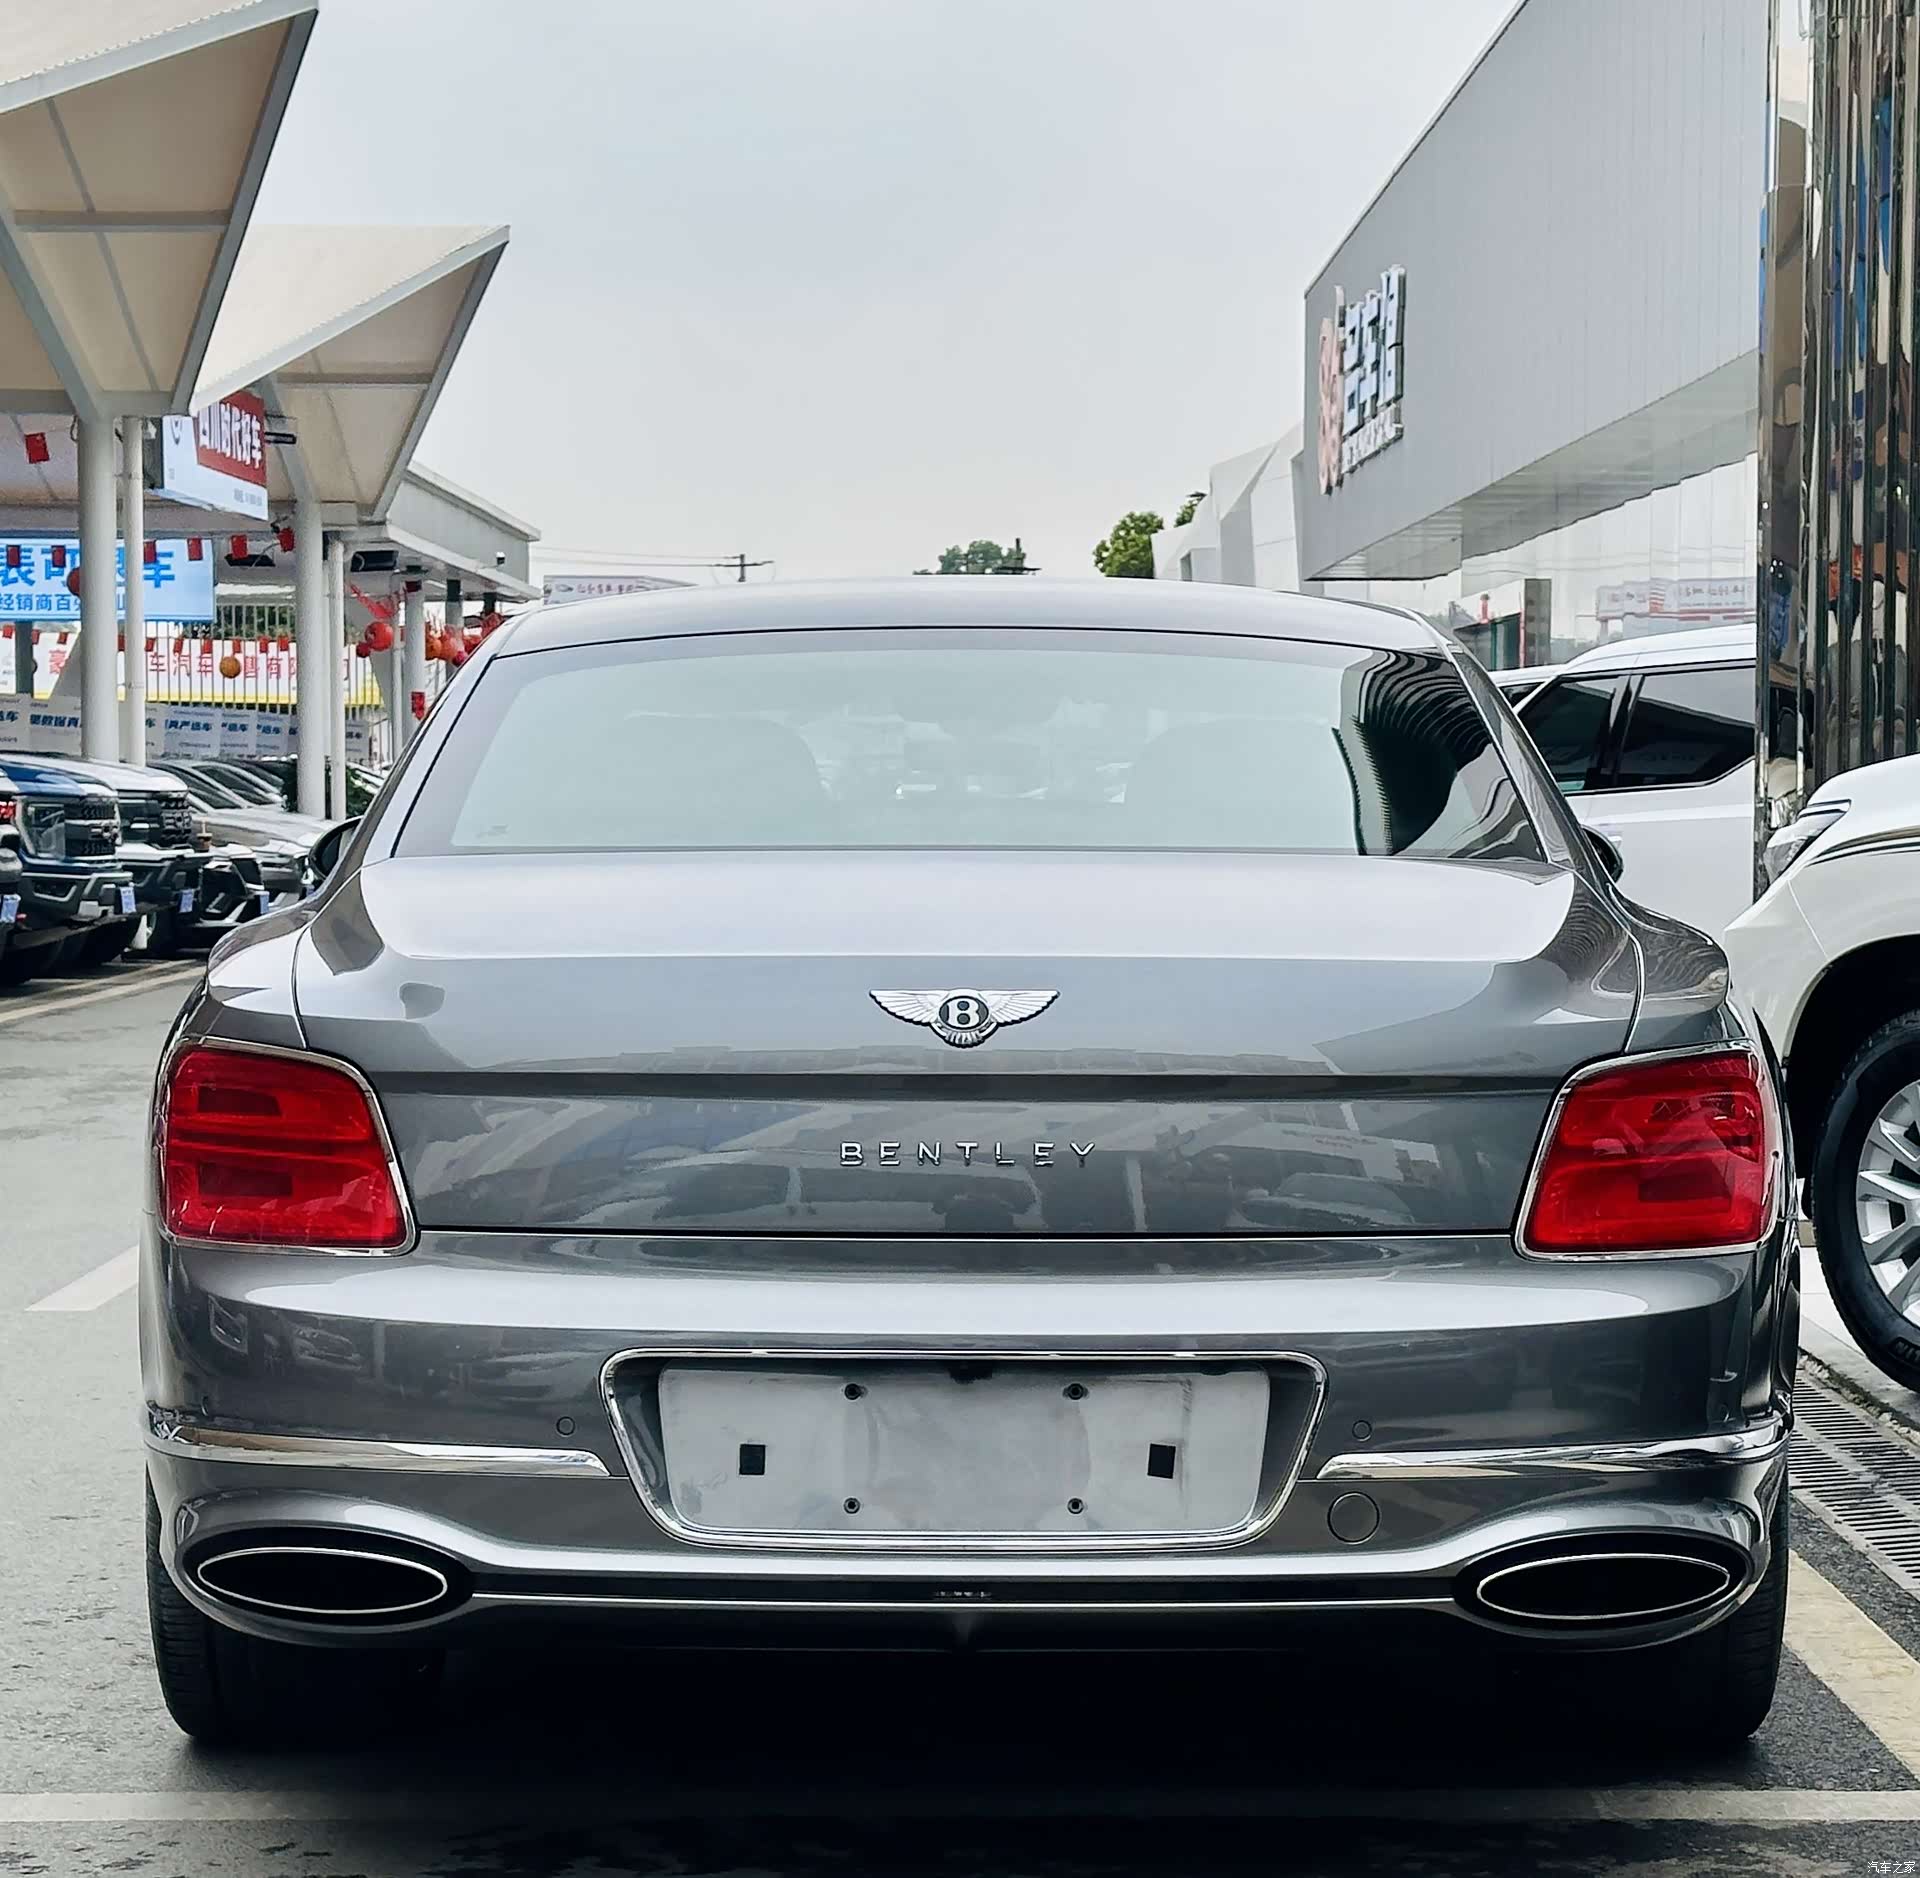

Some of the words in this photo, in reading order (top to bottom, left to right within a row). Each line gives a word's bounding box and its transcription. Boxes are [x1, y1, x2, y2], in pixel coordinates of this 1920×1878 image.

[0, 546, 175, 588] 表可车
[945, 997, 982, 1028] B
[840, 1141, 1095, 1167] BENTLEY
